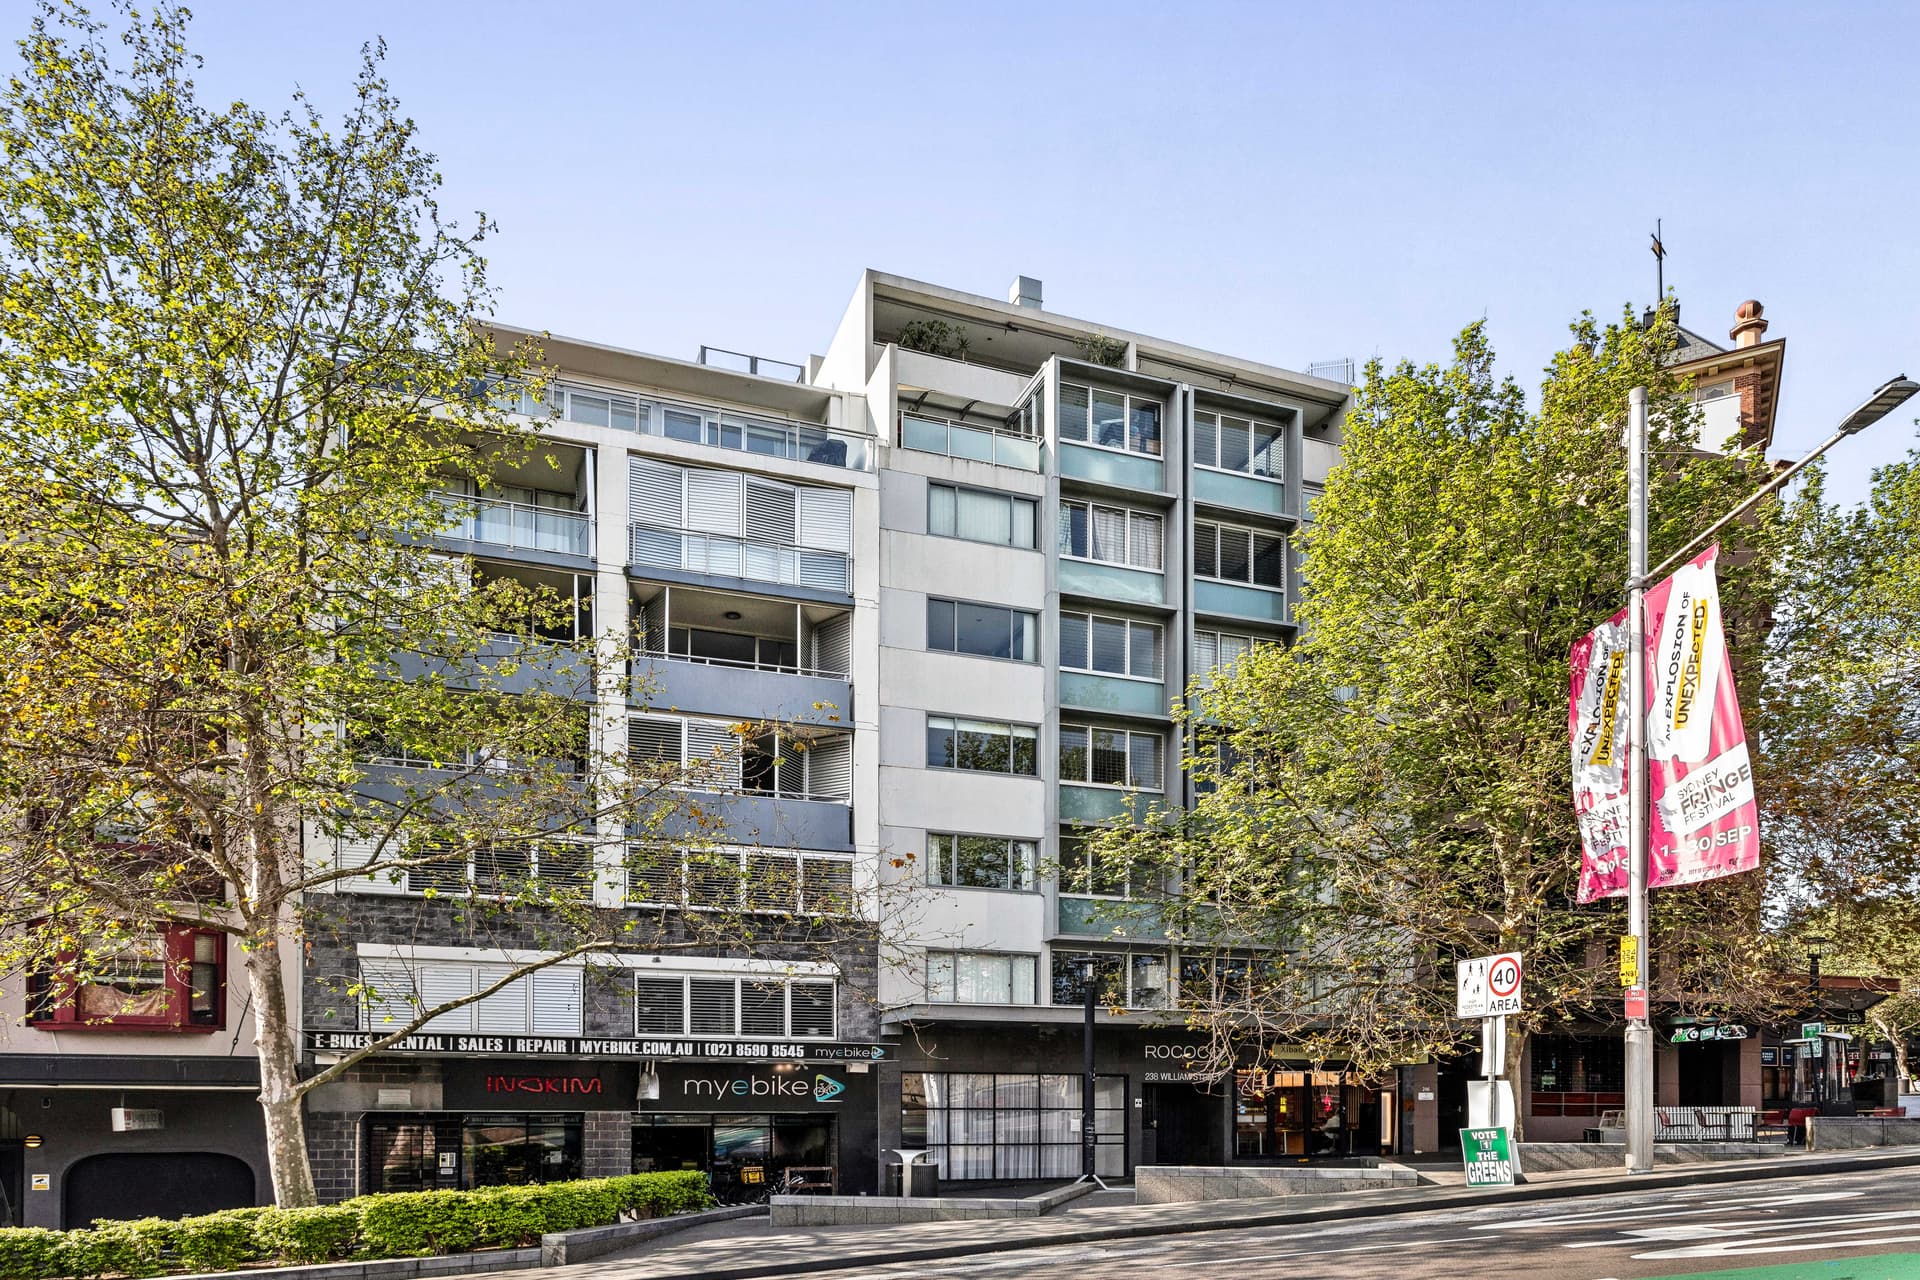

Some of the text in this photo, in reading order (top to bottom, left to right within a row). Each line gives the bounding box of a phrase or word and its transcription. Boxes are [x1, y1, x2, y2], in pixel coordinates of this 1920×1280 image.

[1664, 614, 1688, 719] EXPLOSION
[1681, 591, 1691, 609] OF
[1677, 605, 1706, 723] UNEXPECTED
[1597, 657, 1621, 761] UNEXPECTED
[1677, 768, 1719, 800] SYDNEY
[1680, 763, 1751, 815] FRINGE
[1684, 792, 1736, 826] FESTIVAL
[1592, 831, 1623, 850] FESTI
[1715, 825, 1752, 847] SEP
[1494, 968, 1515, 985] 40
[1489, 998, 1519, 1012] AREA
[458, 1037, 503, 1051] SALES
[516, 1038, 567, 1053] REPAIR
[580, 1040, 693, 1055] MYEBIKE.COM.AU
[705, 1043, 732, 1057] (02)
[736, 1043, 768, 1057] 8590
[771, 1044, 804, 1058] 8545
[815, 1046, 871, 1059] myebike
[1145, 1072, 1159, 1081] 238
[683, 1075, 809, 1101] myebike
[1471, 1131, 1498, 1140] VOTE
[1483, 1141, 1489, 1149] 1
[1476, 1151, 1498, 1161] THE
[1468, 1161, 1511, 1183] GREENS
